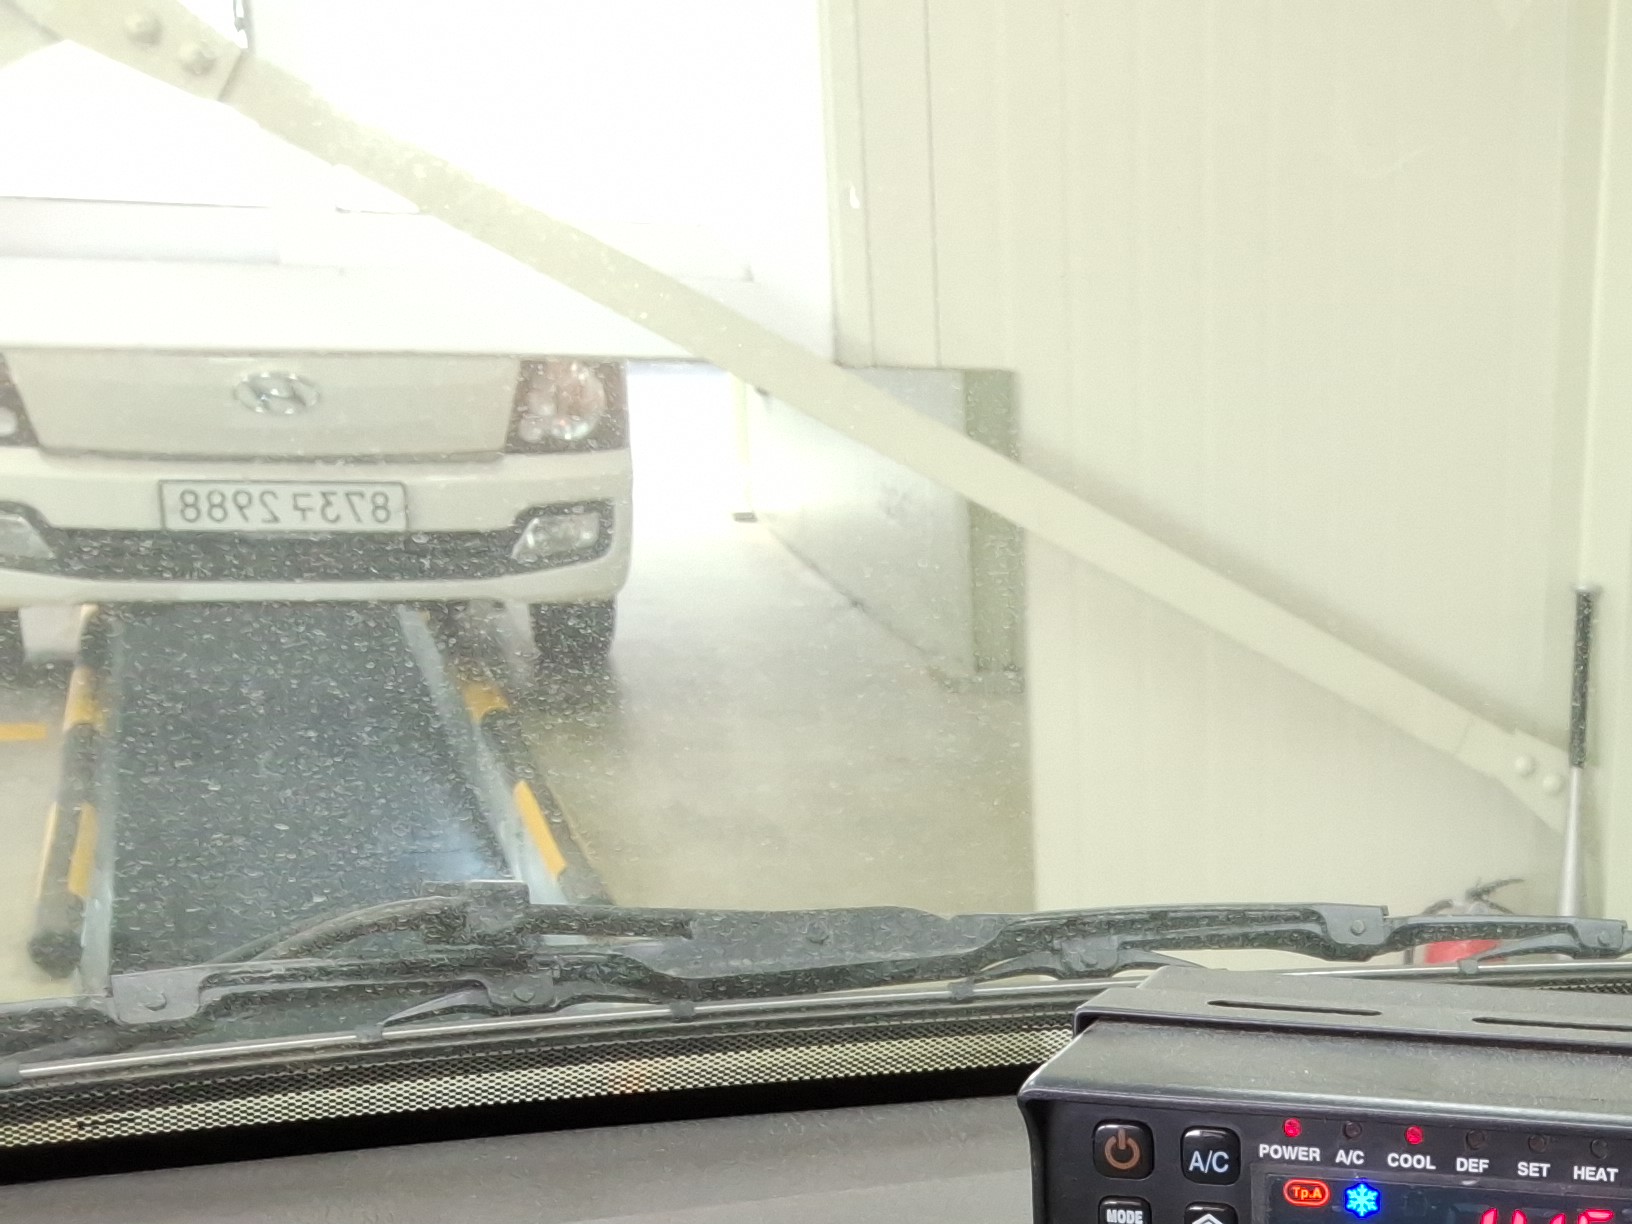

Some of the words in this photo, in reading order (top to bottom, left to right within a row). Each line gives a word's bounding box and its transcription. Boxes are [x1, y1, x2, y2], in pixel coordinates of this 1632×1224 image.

[1259, 1144, 1320, 1162] POWER
[1335, 1149, 1365, 1165] A/C
[1189, 1151, 1230, 1173] A/C
[1387, 1153, 1436, 1170] COOL
[1456, 1157, 1489, 1173] DEF
[1517, 1161, 1550, 1177] SET
[1573, 1165, 1618, 1182] HEAT
[1291, 1186, 1323, 1201] Tp.A
[1106, 1209, 1143, 1224] MODE
